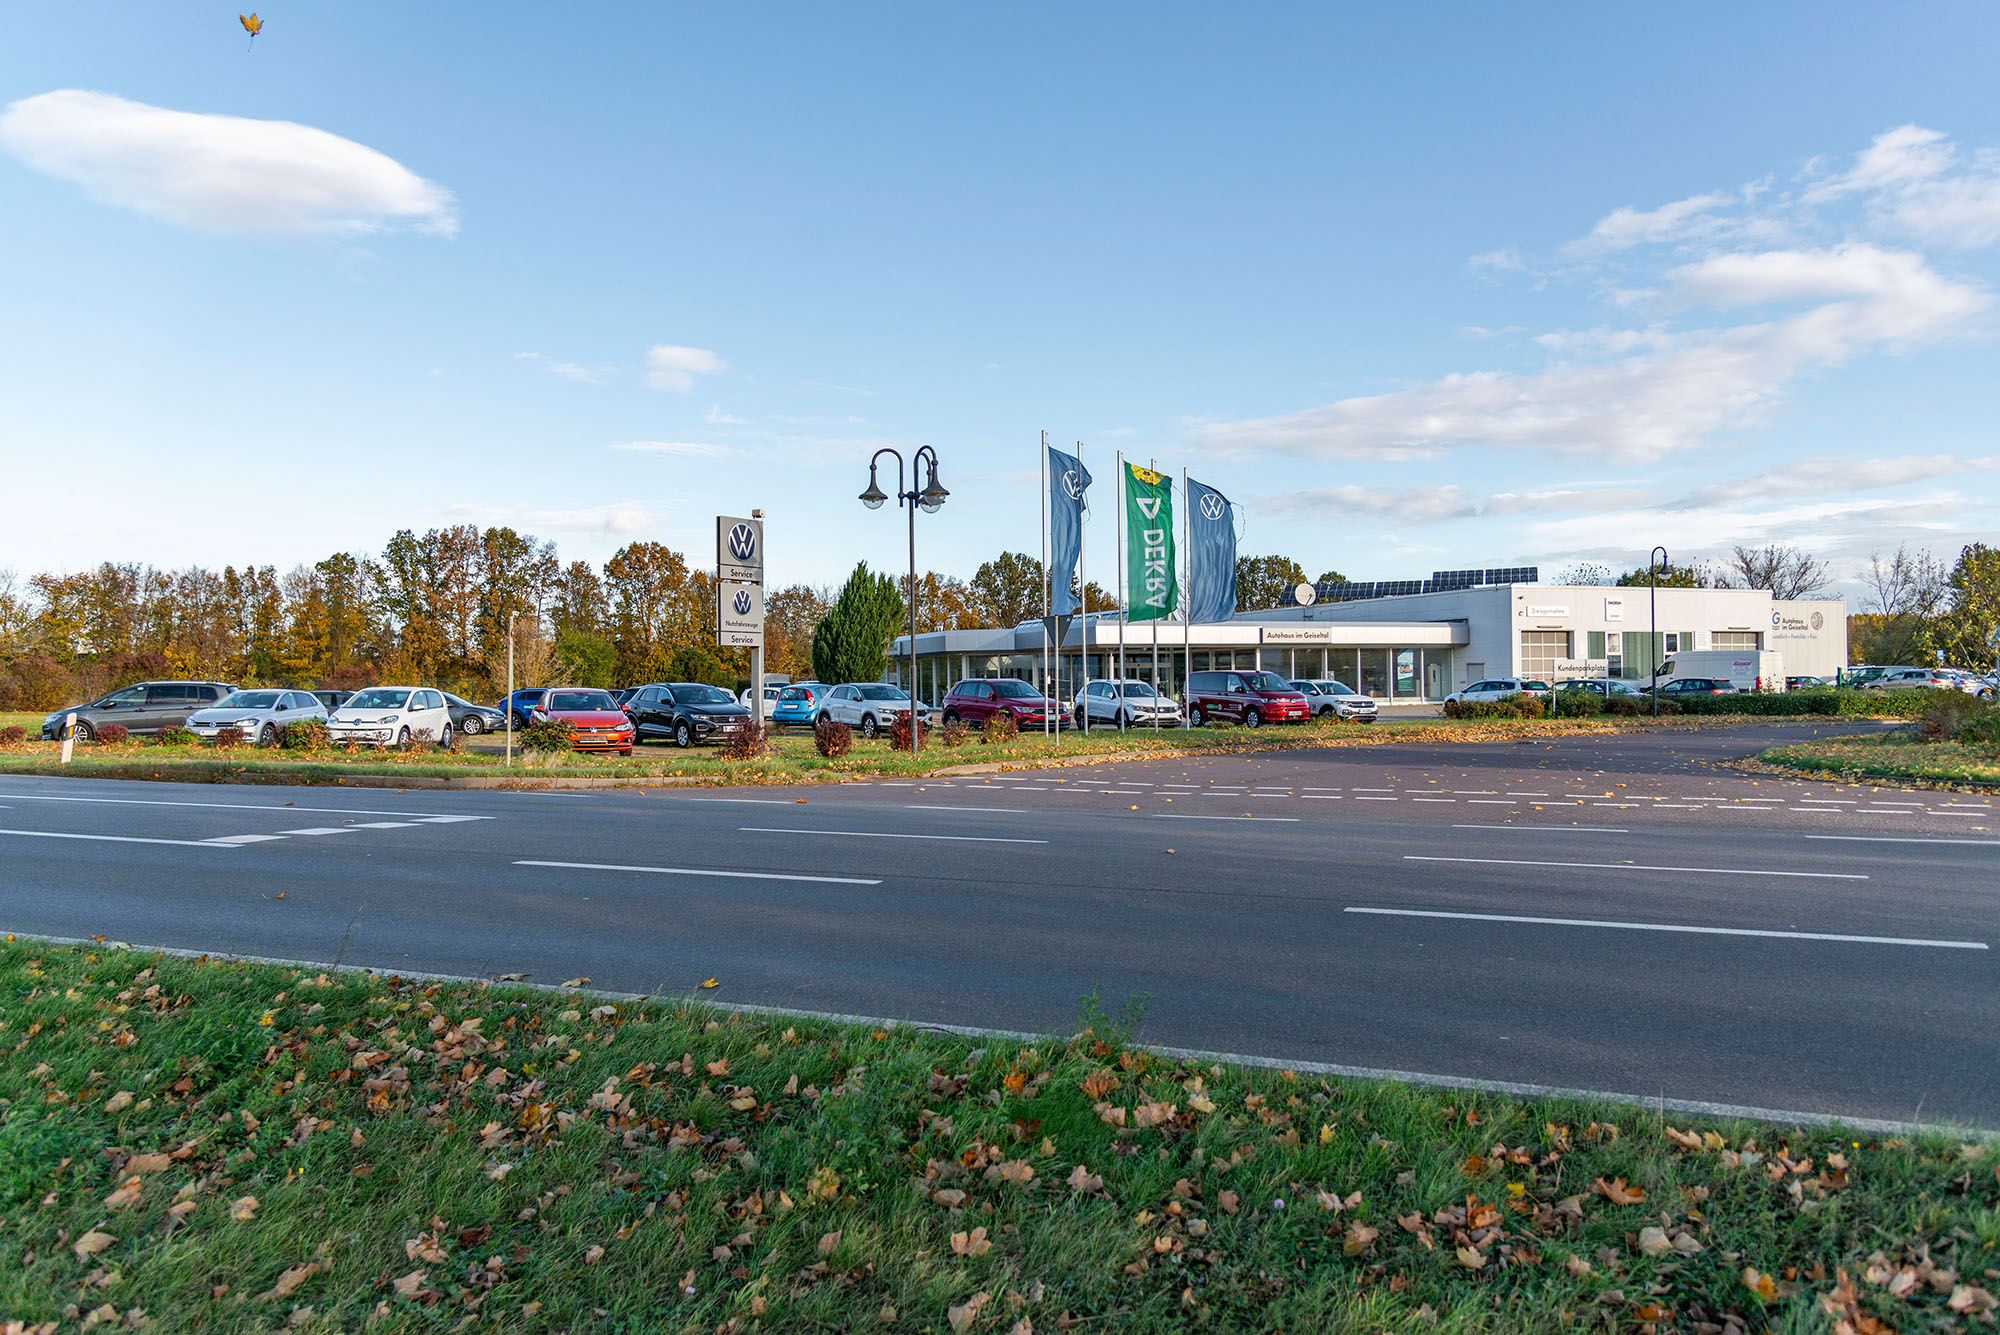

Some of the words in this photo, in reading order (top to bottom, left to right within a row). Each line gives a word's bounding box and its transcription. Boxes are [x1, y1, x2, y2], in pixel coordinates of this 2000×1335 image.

[728, 523, 756, 560] VW
[730, 568, 753, 578] Service
[1143, 529, 1166, 608] DEKRA
[725, 619, 758, 629] Nutzfahrzeuge
[1788, 623, 1808, 631] Geiseltal
[731, 634, 753, 644] Service
[1267, 631, 1294, 639] Autohaus
[1295, 631, 1303, 639] im
[1304, 631, 1329, 639] Geiseltal
[1557, 664, 1606, 672] Kundenparkplatz
